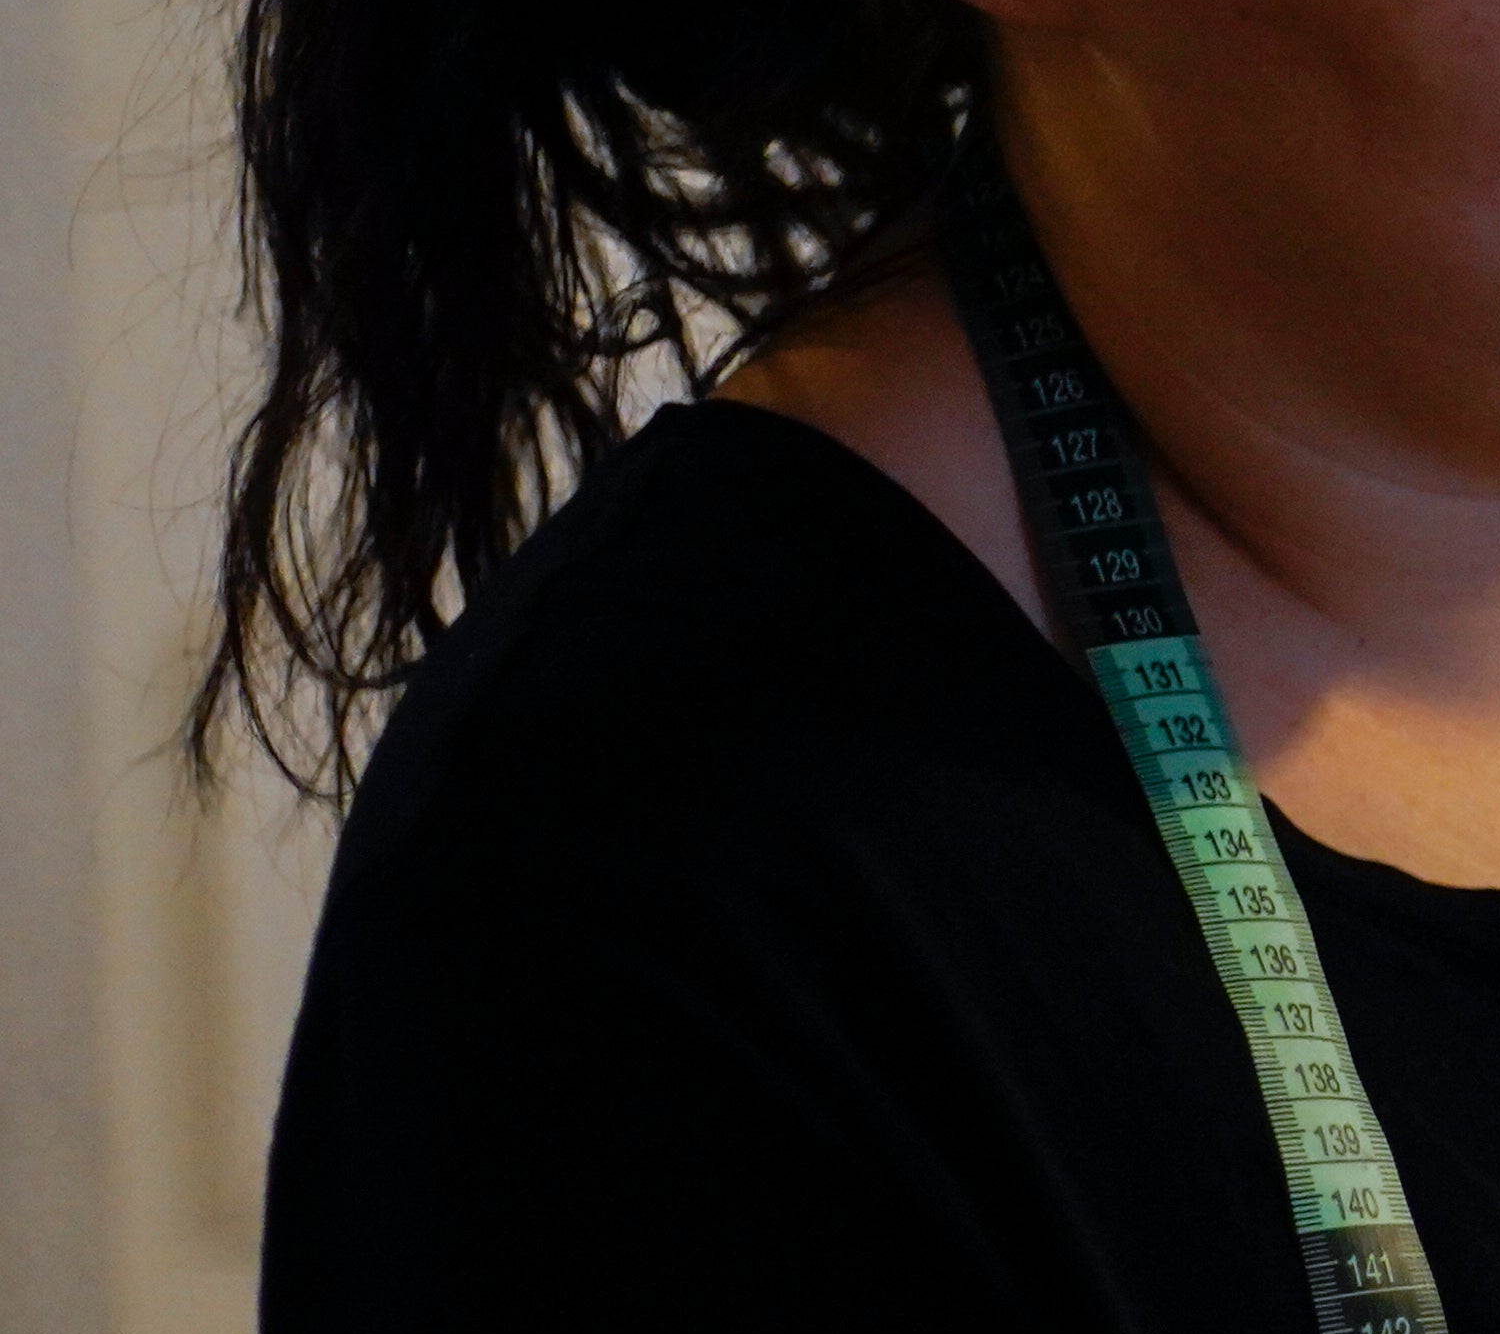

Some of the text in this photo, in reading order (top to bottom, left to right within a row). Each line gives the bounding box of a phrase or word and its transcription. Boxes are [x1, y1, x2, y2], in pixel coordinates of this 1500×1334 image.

[1014, 315, 1066, 350] 125
[1030, 370, 1085, 405] 126
[1051, 428, 1100, 466] 127
[1069, 488, 1123, 526] 128
[1087, 549, 1142, 585] 129
[1111, 605, 1163, 639] 130
[1133, 661, 1186, 693] 131
[1156, 715, 1211, 749] 132
[1180, 770, 1233, 803] 133
[1203, 828, 1254, 860] 134
[1227, 885, 1277, 918] 135
[1249, 944, 1298, 976] 136
[1273, 1003, 1319, 1035] 137
[1294, 1061, 1342, 1095] 138
[1313, 1124, 1362, 1158] 139
[1330, 1186, 1381, 1222] 140
[1346, 1254, 1397, 1289] 141
